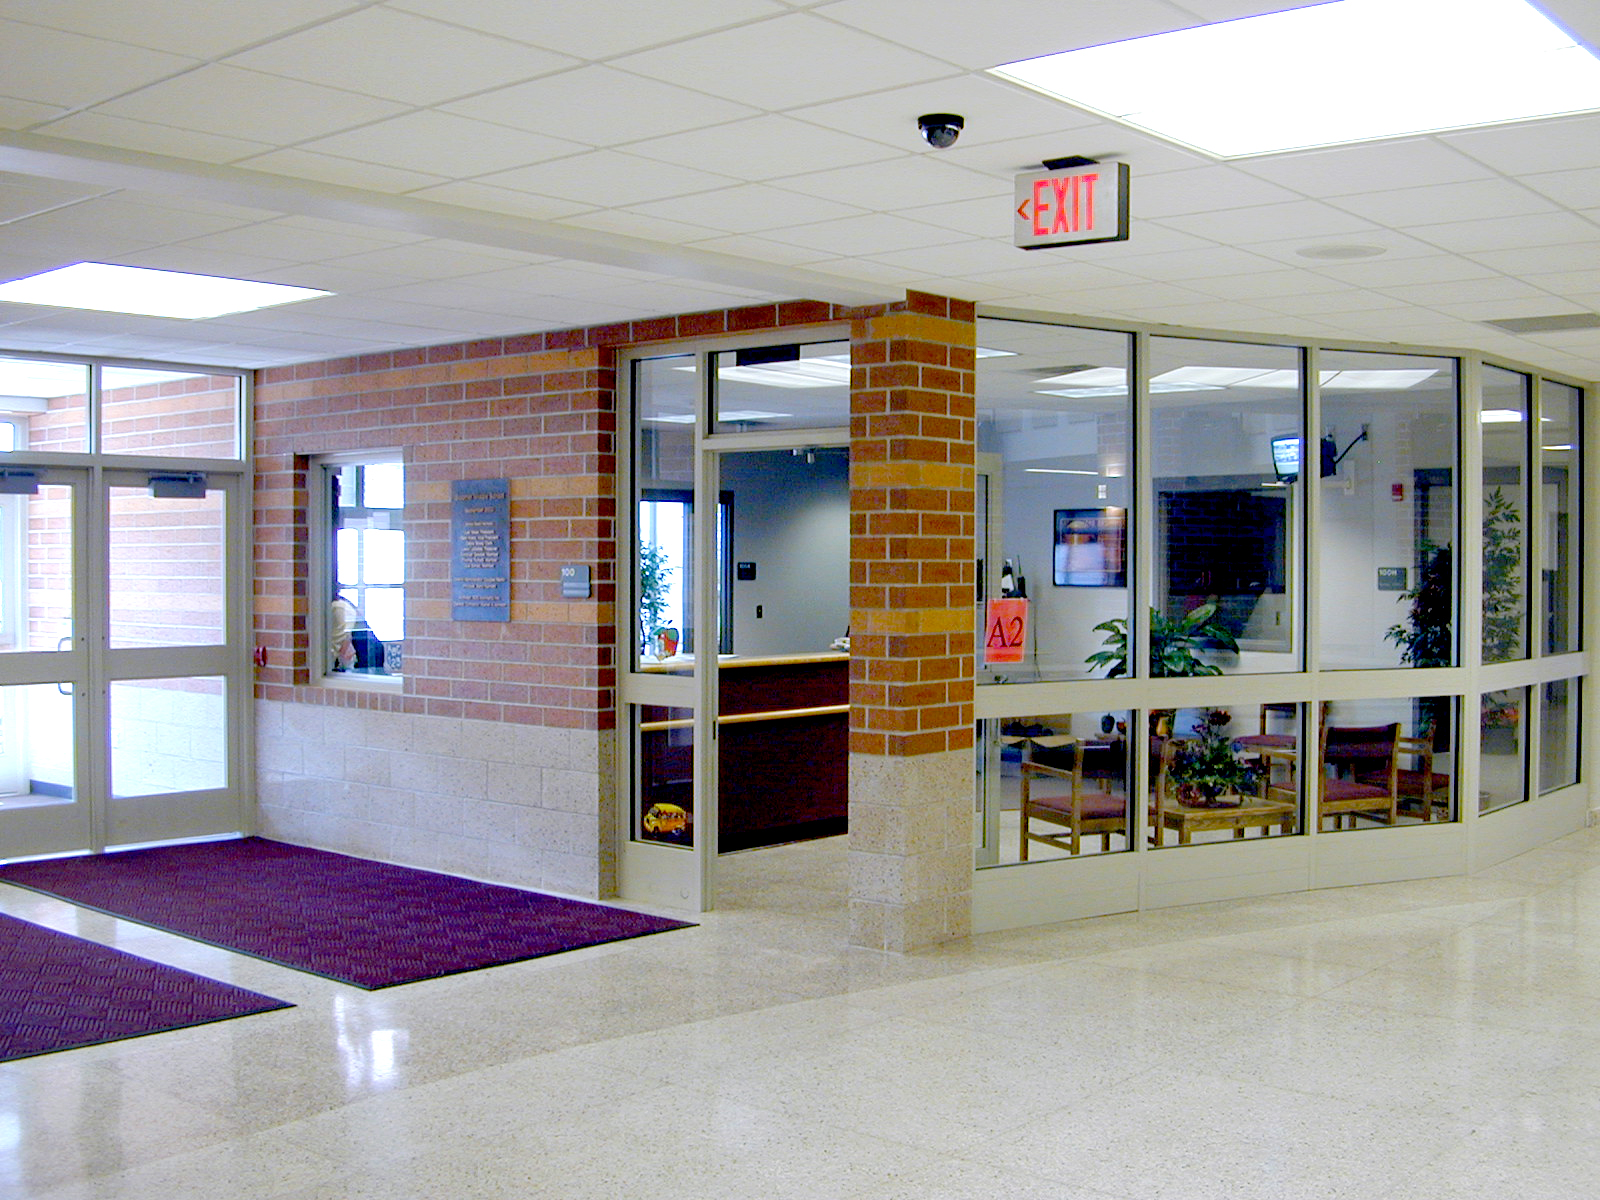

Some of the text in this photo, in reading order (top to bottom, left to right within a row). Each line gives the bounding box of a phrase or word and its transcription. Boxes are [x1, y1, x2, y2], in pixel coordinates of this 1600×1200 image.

[1033, 173, 1099, 236] EXIT
[561, 568, 576, 577] 100
[986, 615, 1024, 648] A2
